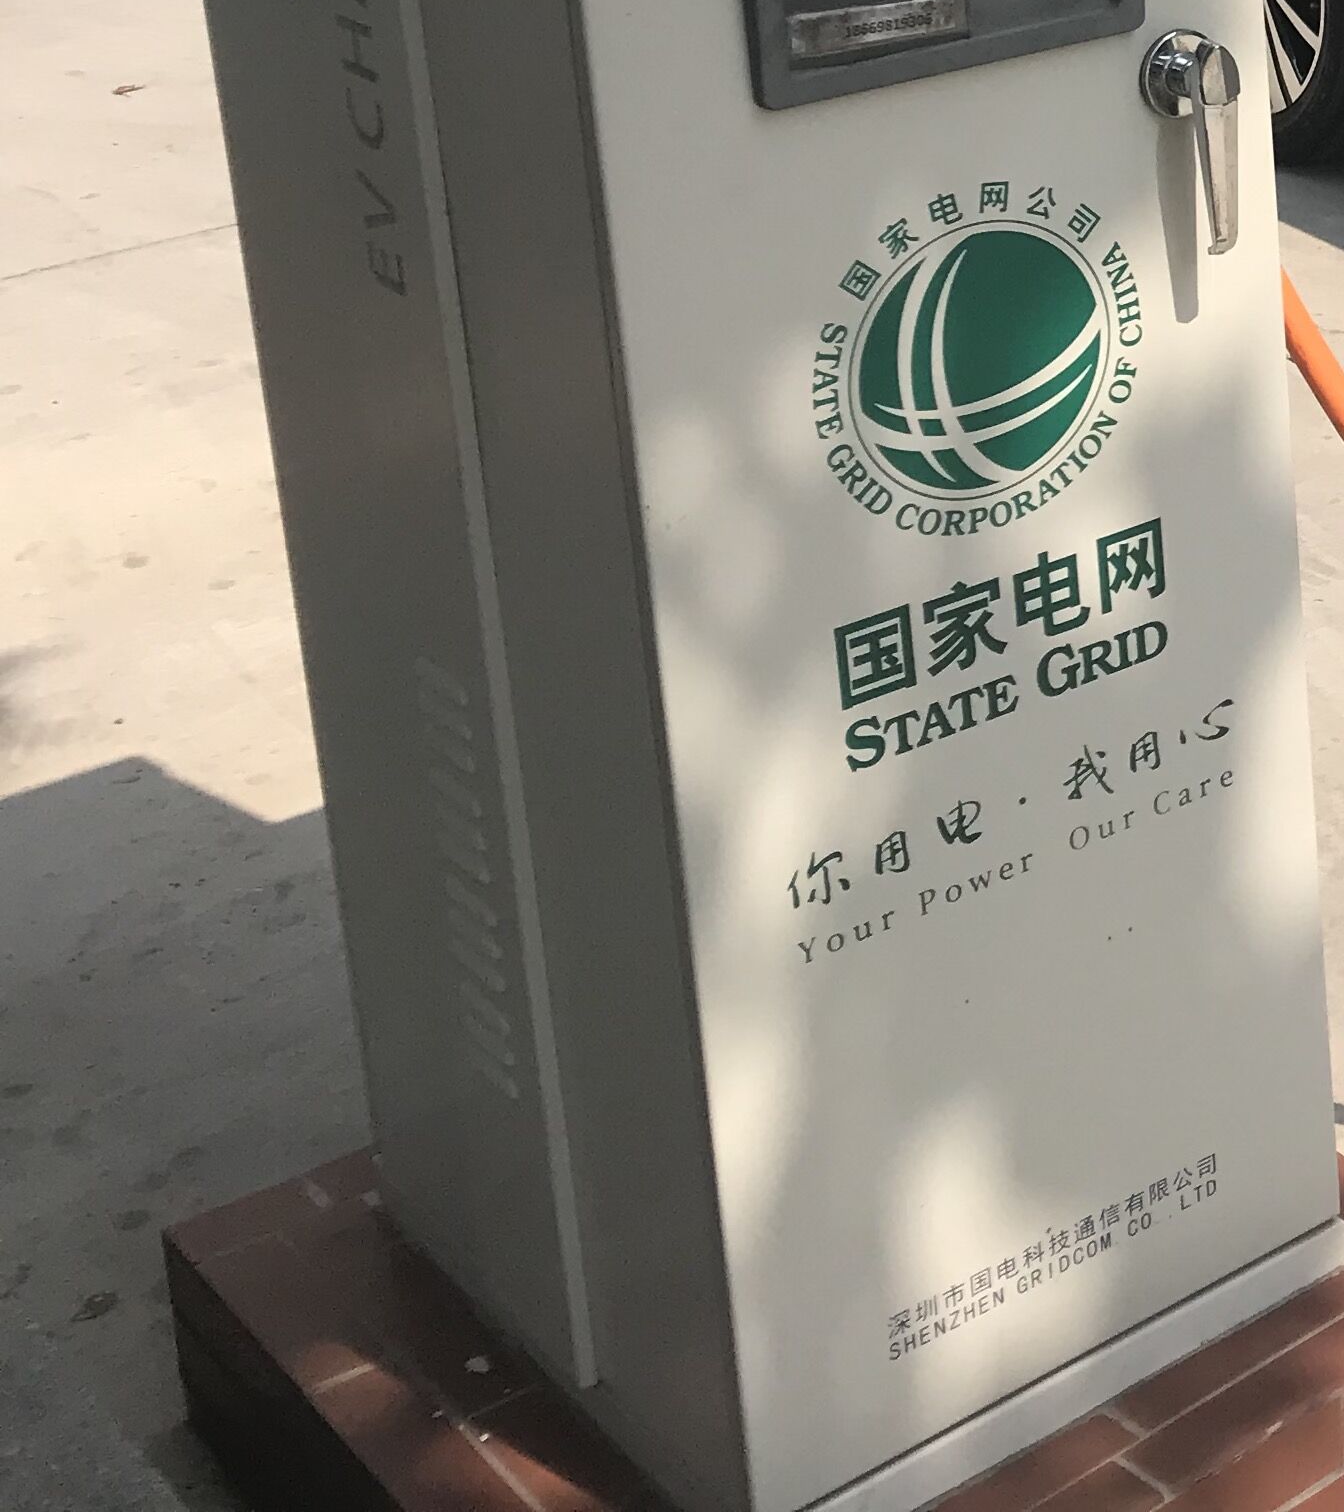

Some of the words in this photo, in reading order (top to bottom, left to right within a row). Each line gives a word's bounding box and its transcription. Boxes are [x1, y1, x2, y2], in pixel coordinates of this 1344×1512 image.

[346, 170, 406, 296] EV
[838, 180, 1101, 301] 国家电网公司
[1101, 240, 1143, 347] CHINA
[812, 322, 849, 440] STATE
[1108, 360, 1138, 406] OF
[826, 443, 894, 516] GRID
[895, 410, 1119, 537] CORPORATION
[833, 516, 1167, 711] 国家电网
[844, 674, 1019, 773] STATE
[1035, 619, 1169, 698] GRID
[798, 909, 896, 964] Your
[918, 851, 1034, 917] Power
[1068, 809, 1136, 852] Our
[1152, 767, 1235, 817] Care
[888, 1152, 1218, 1340] 深圳市国电科技通信有限公司
[888, 1287, 1006, 1362] SHENZHEN
